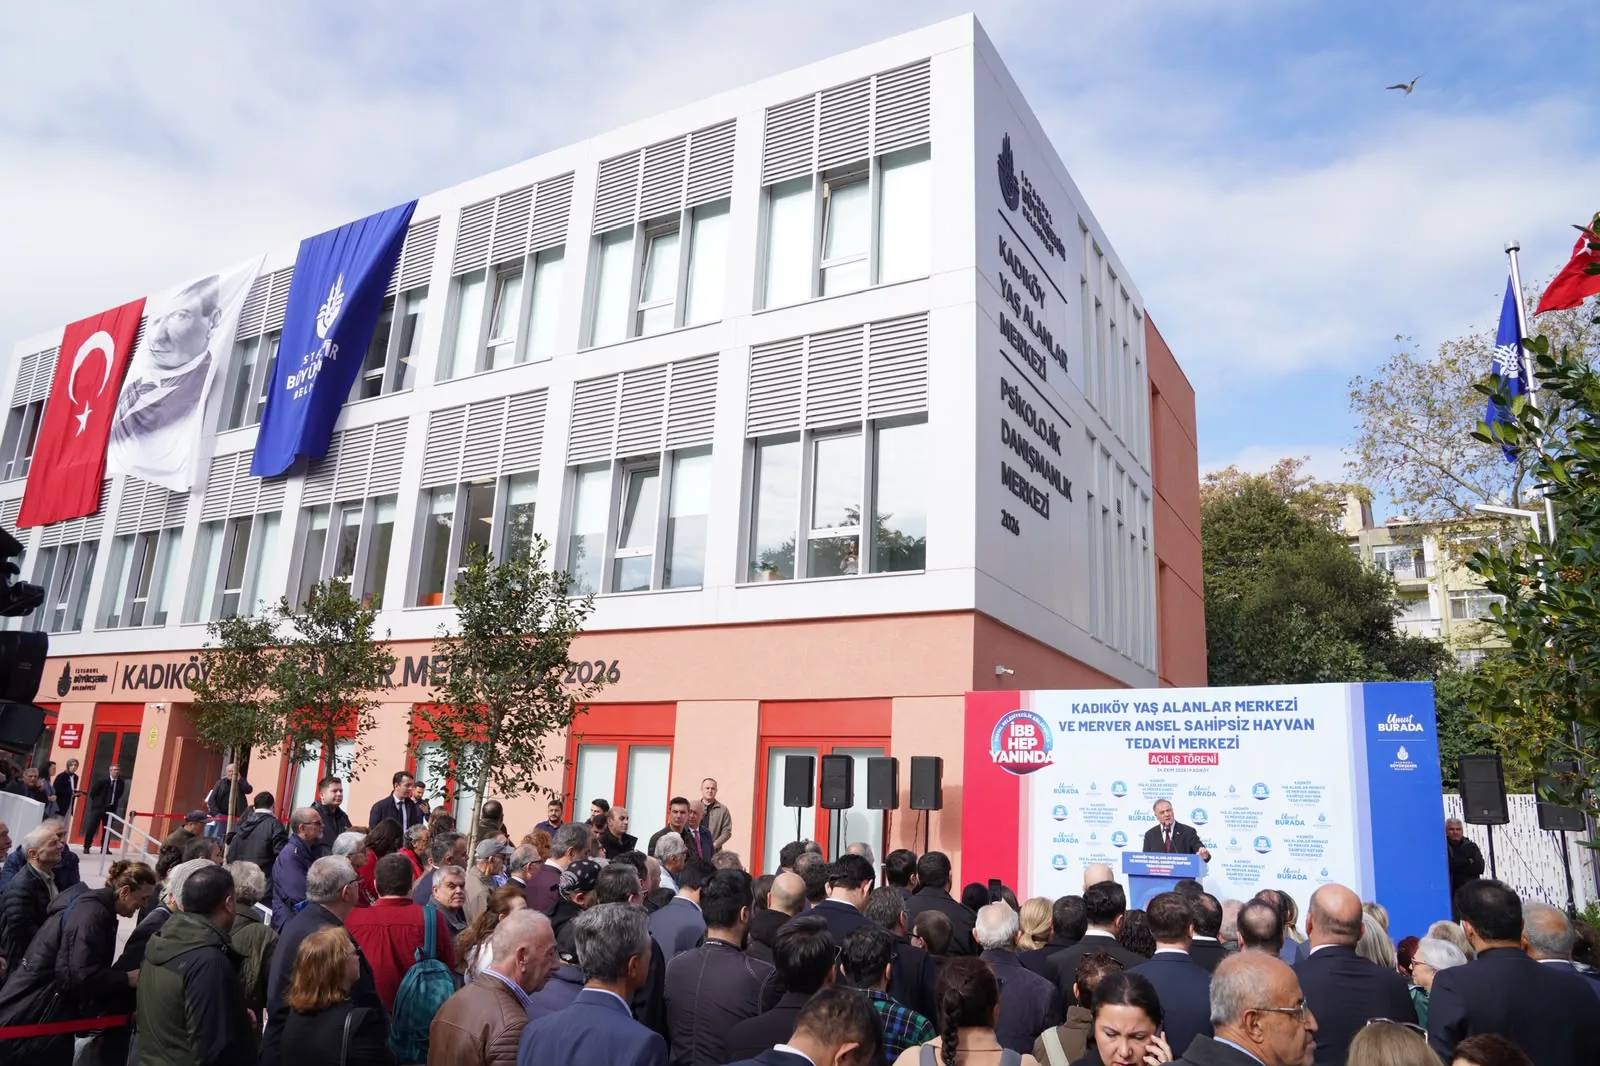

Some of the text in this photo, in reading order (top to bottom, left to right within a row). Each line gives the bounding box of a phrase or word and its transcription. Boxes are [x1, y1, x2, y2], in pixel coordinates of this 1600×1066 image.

[999, 234, 1046, 309] KADIKÖY
[999, 271, 1068, 373] YAŞ ALANLAR
[1000, 311, 1047, 382] MERKEZİ
[1001, 377, 1061, 456] PSİKOLOJİK
[1001, 418, 1072, 502] DANIŞMANLIK
[1001, 461, 1049, 520] MERKEZİ
[1001, 509, 1020, 536] 2026
[122, 655, 214, 690] KADIKÖY
[564, 660, 620, 684] 2026
[1072, 696, 1298, 716] KADIKÖY YAŞ ALANLAR MERKEZİ
[1058, 721, 1076, 732] VE
[1078, 720, 1132, 732] MERVER
[1134, 720, 1181, 732] ANSEL
[1184, 716, 1250, 732] SAHİPSİZ
[1253, 718, 1315, 731] HAYVAN
[1378, 723, 1424, 732] BURADA
[1387, 713, 1414, 724] Umut
[1010, 721, 1036, 737] İBB
[1008, 737, 1038, 750] HEP
[1126, 734, 1240, 750] TEDAVİ MERKEZİ
[988, 750, 1055, 764] YANINDA
[1150, 753, 1217, 766] AÇILIŞ TÖRENİ
